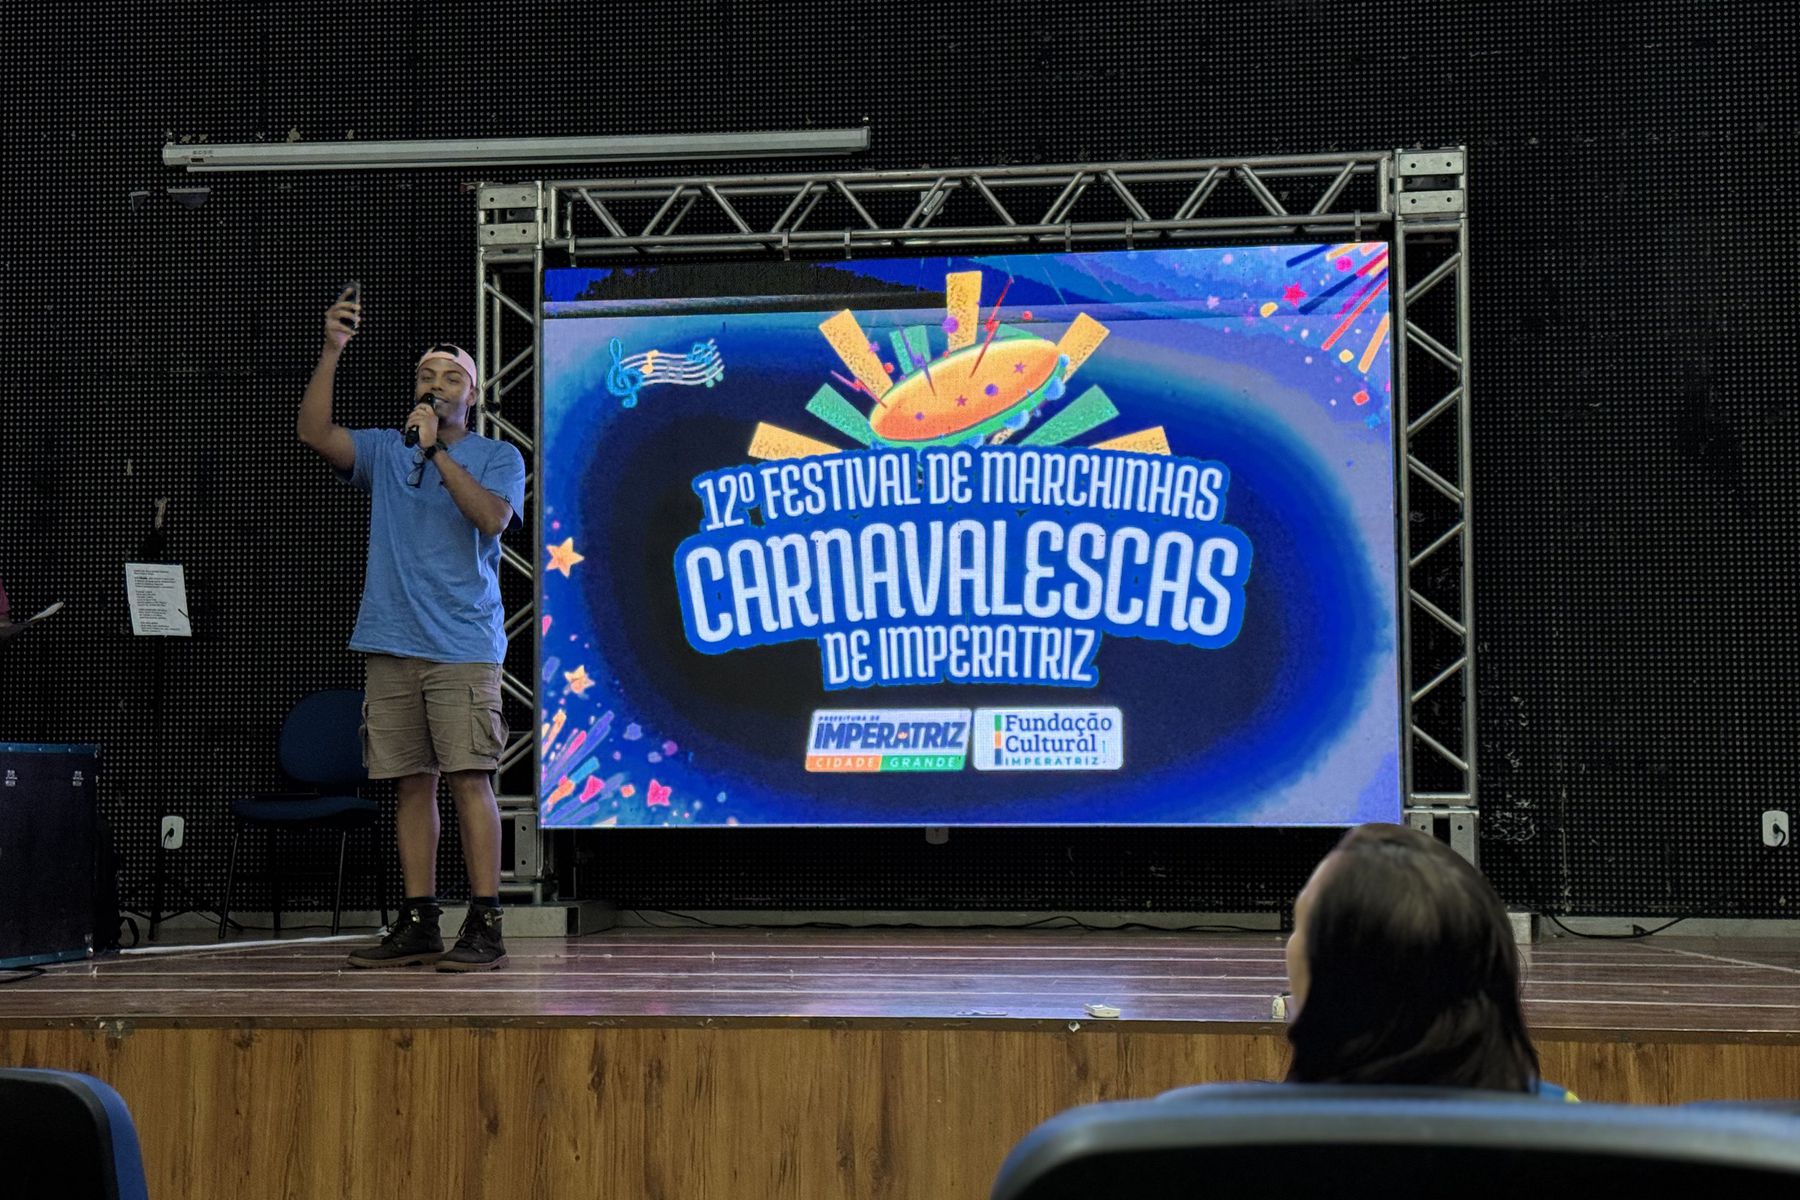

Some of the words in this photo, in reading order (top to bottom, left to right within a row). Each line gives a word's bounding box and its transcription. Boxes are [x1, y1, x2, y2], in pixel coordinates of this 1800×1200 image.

[760, 453, 921, 520] FESTIVAL
[926, 451, 973, 504] DE
[981, 451, 1223, 521] MARCHINHAS
[685, 519, 1239, 642] CARNAVALESCAS
[823, 630, 873, 684] DE
[879, 624, 1095, 681] IMPERATRIZ
[814, 722, 967, 749] IMPERATRIZ
[1004, 713, 1113, 737] Fundação
[1005, 734, 1097, 753] Cultural
[815, 757, 875, 768] CIDADE
[889, 757, 956, 768] GRANDE
[1004, 756, 1099, 766] IMPERATRIZ
